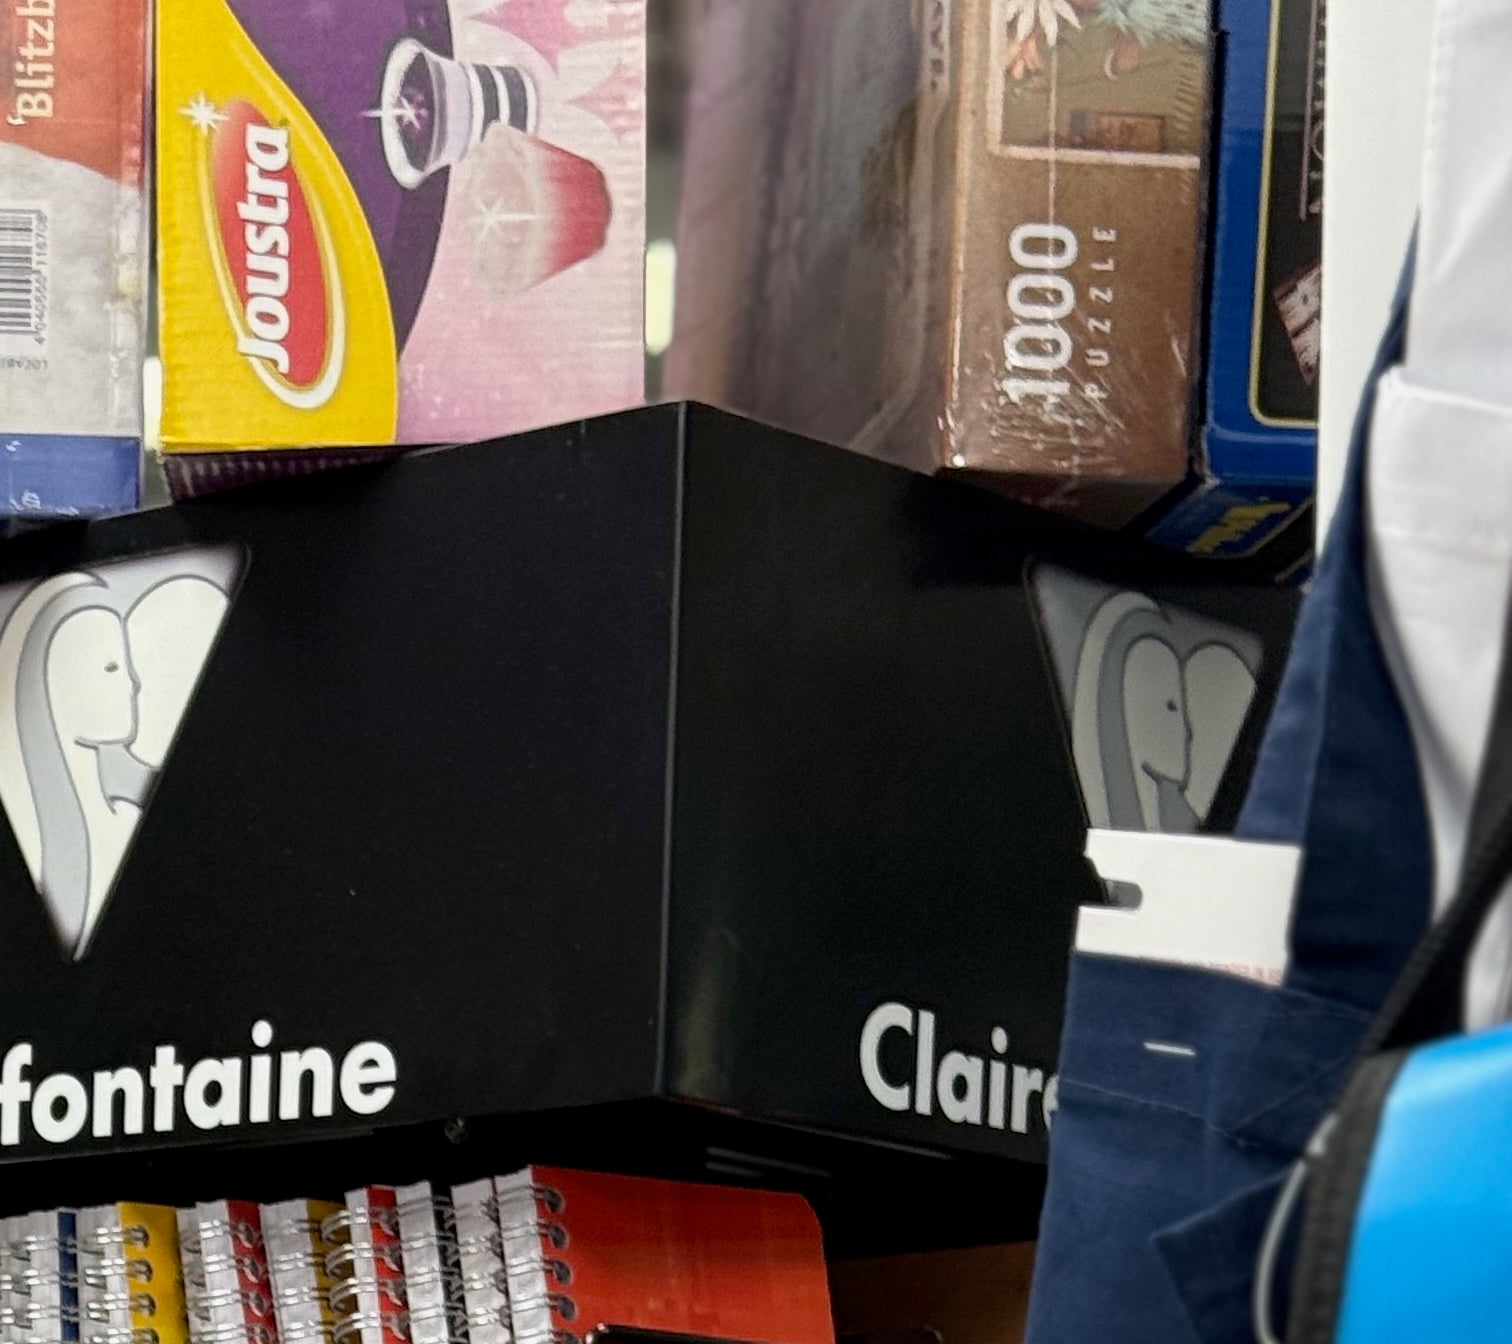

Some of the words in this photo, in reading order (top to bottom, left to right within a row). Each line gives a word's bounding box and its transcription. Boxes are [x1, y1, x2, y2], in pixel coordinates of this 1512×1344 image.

[237, 123, 290, 374] Joustra
[1001, 223, 1078, 405] 1000
[1085, 226, 1117, 400] PUZZLE
